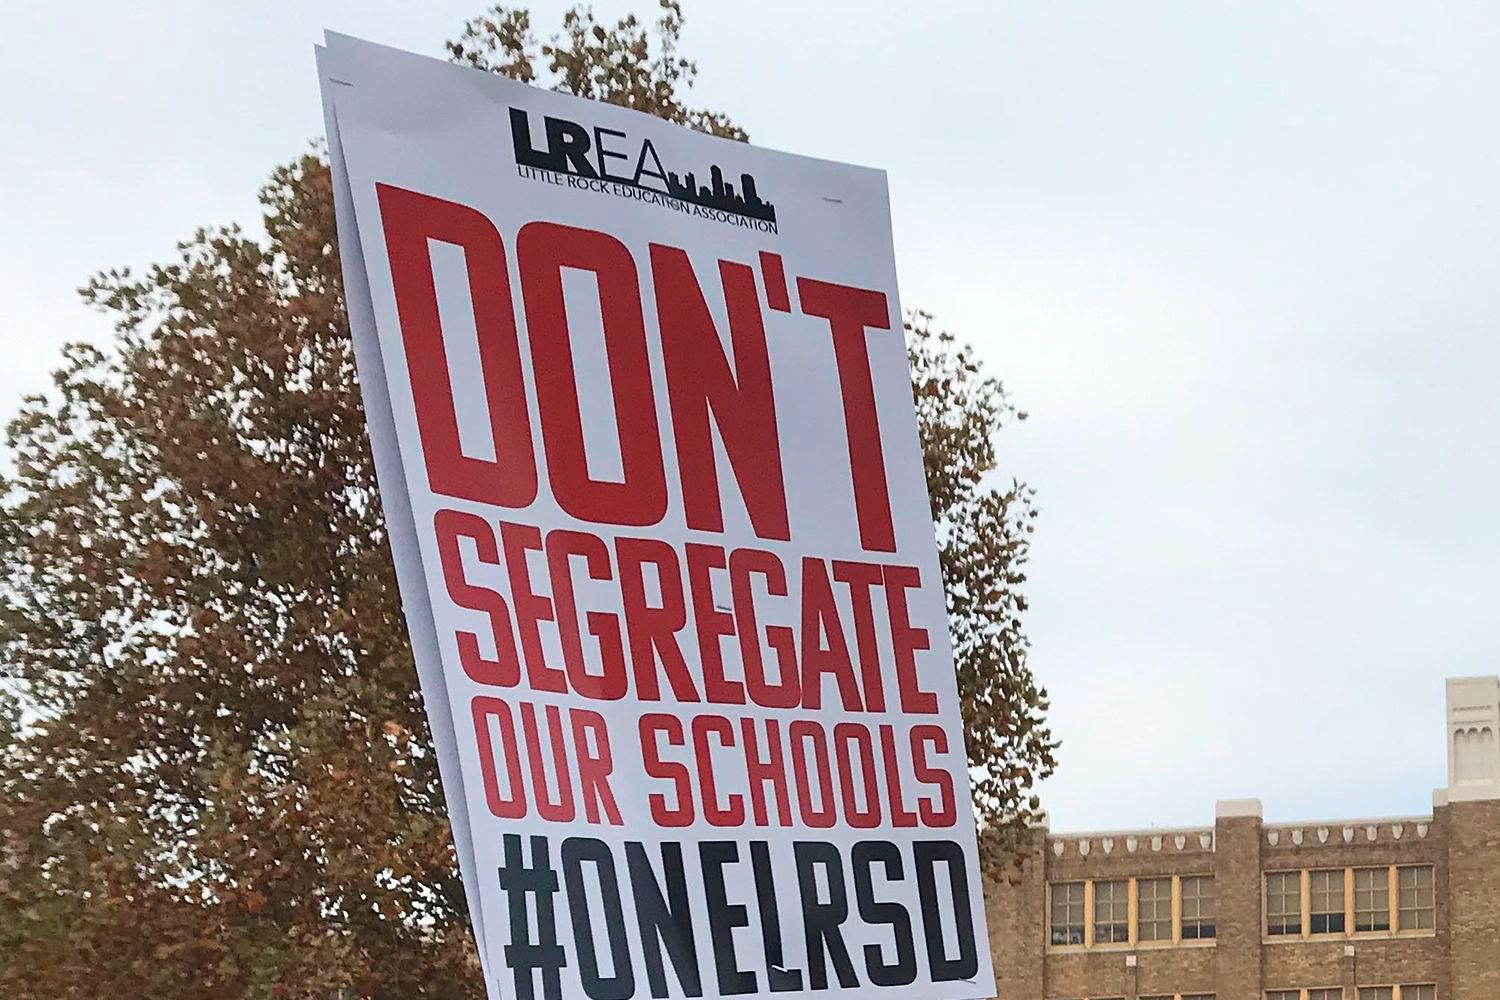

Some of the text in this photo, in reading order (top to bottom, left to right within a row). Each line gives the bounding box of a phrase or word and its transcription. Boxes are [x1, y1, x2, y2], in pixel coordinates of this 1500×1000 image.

[509, 107, 670, 189] LREA
[517, 165, 779, 234] LITTLE ROCK EDUCATION ASSOCIATION
[375, 182, 896, 553] DON'T
[434, 509, 938, 714] SEGREGATE
[471, 696, 957, 828] OUR SCHOOLS
